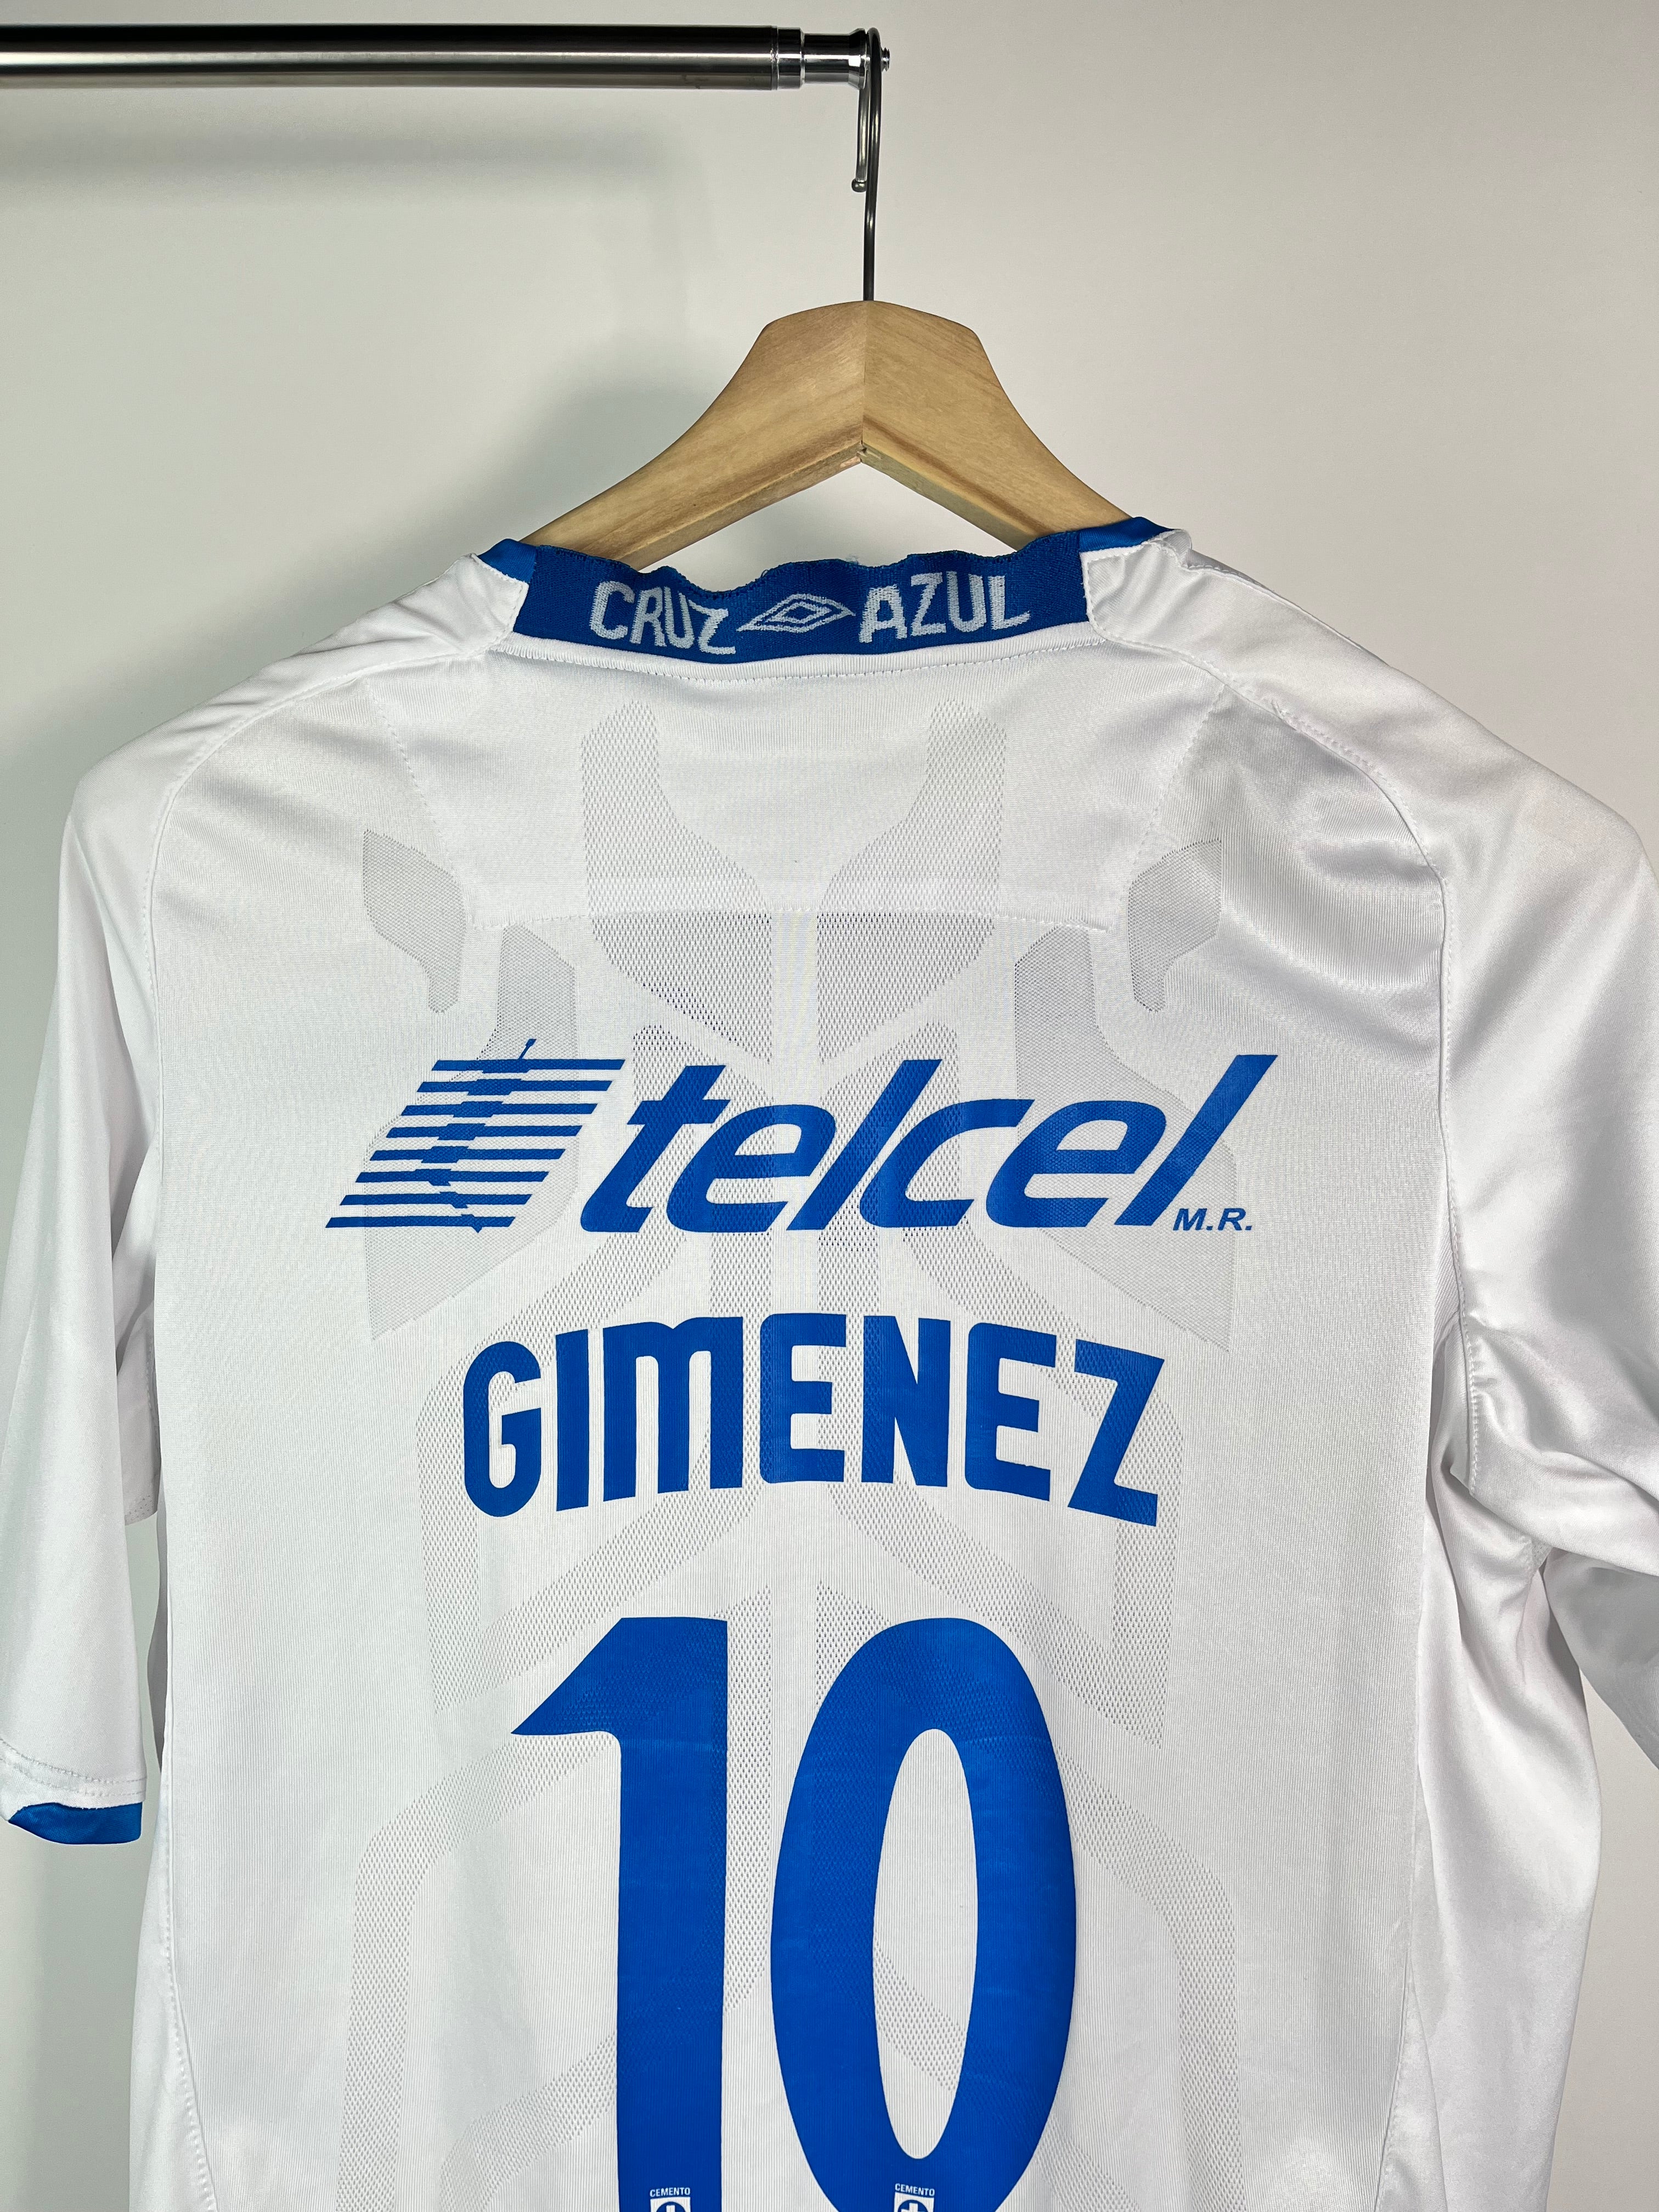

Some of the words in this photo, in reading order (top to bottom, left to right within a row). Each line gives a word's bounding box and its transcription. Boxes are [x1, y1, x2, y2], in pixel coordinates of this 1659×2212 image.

[589, 580, 736, 655] CRUZ
[859, 571, 1030, 644] AZUL
[580, 1054, 1278, 1234] telcel
[1172, 1207, 1252, 1231] M.R.
[462, 1313, 1165, 1527] GIMENEZ
[511, 1616, 1077, 2212] 10
[650, 2187, 691, 2197] CEMENTO
[895, 2183, 935, 2197] CEMENTO
